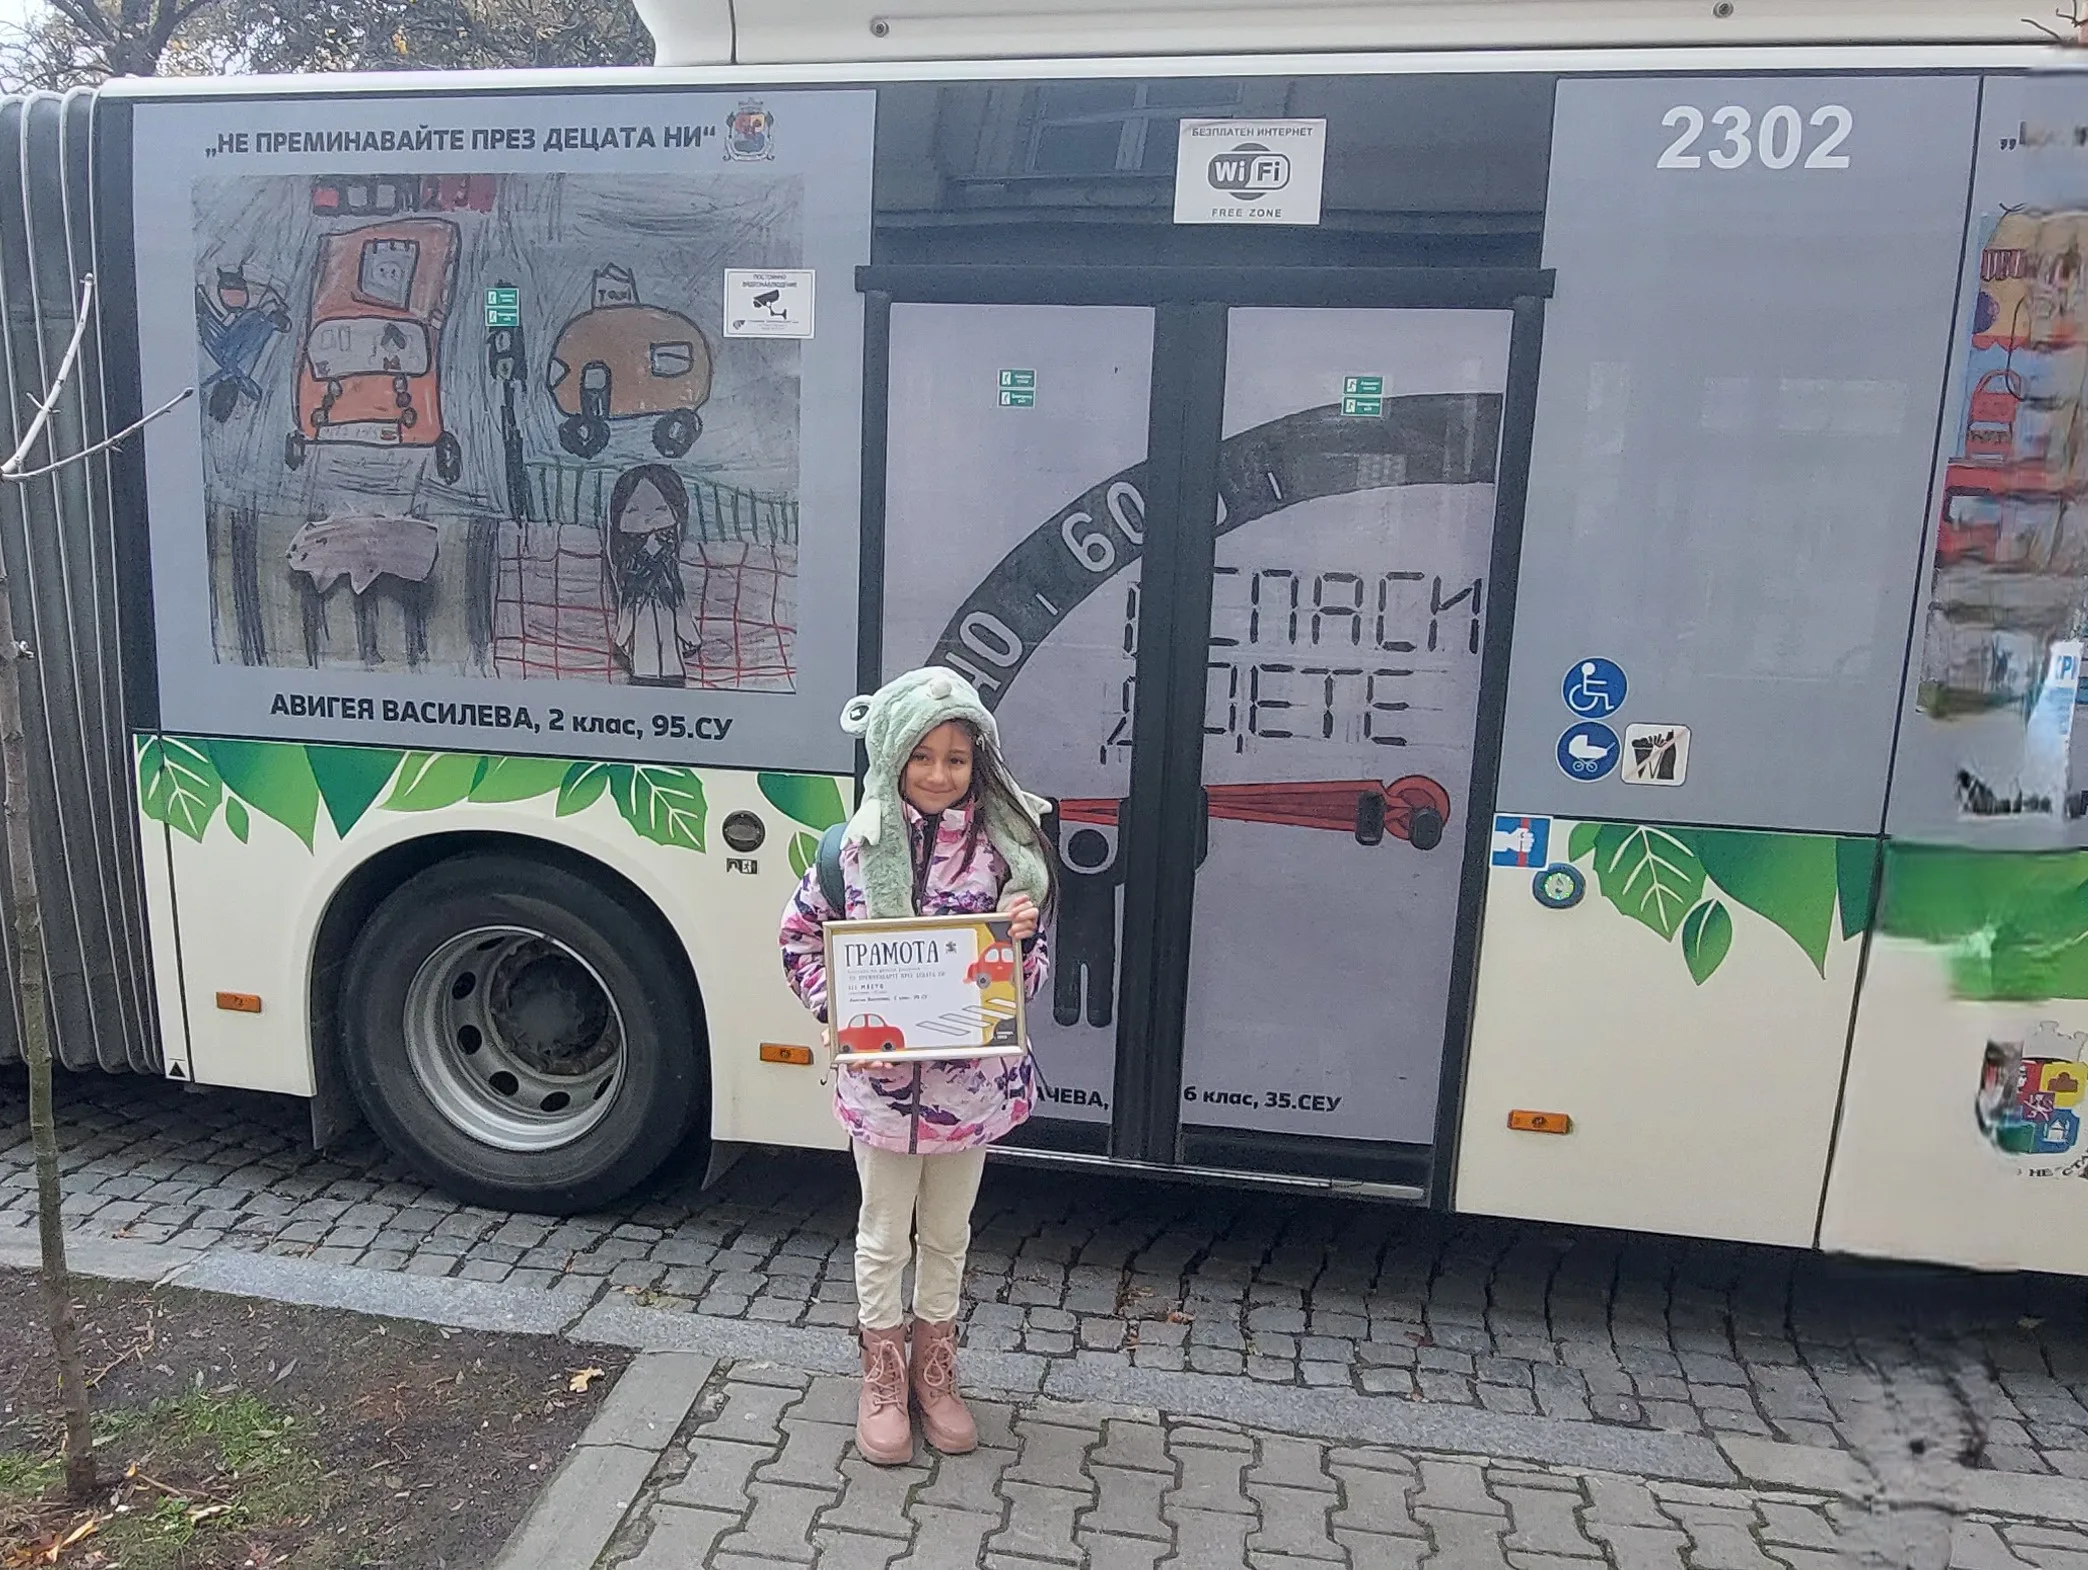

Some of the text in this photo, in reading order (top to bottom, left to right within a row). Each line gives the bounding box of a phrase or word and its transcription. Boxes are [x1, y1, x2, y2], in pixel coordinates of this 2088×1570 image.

[205, 124, 716, 158] „НЕ ПРЕМИНАВАЙТЕ ПРЕЗ ДЕЦАТА НИ“
[1192, 127, 1313, 136] БЕЗПЛАТЕН ИНТЕРНЕТ
[1656, 104, 1853, 169] 2302
[1211, 208, 1282, 217] FREE ZONE
[1061, 481, 1144, 572] 60
[270, 692, 734, 741] АВИГЕЯ ВАСИЛЕВА, 2 клас, 95.СУ
[844, 940, 939, 967] ГРАМОТА
[1183, 1085, 1197, 1101] 6
[1203, 1090, 1258, 1109] клас,
[1264, 1091, 1342, 1112] 35.СЕУ
